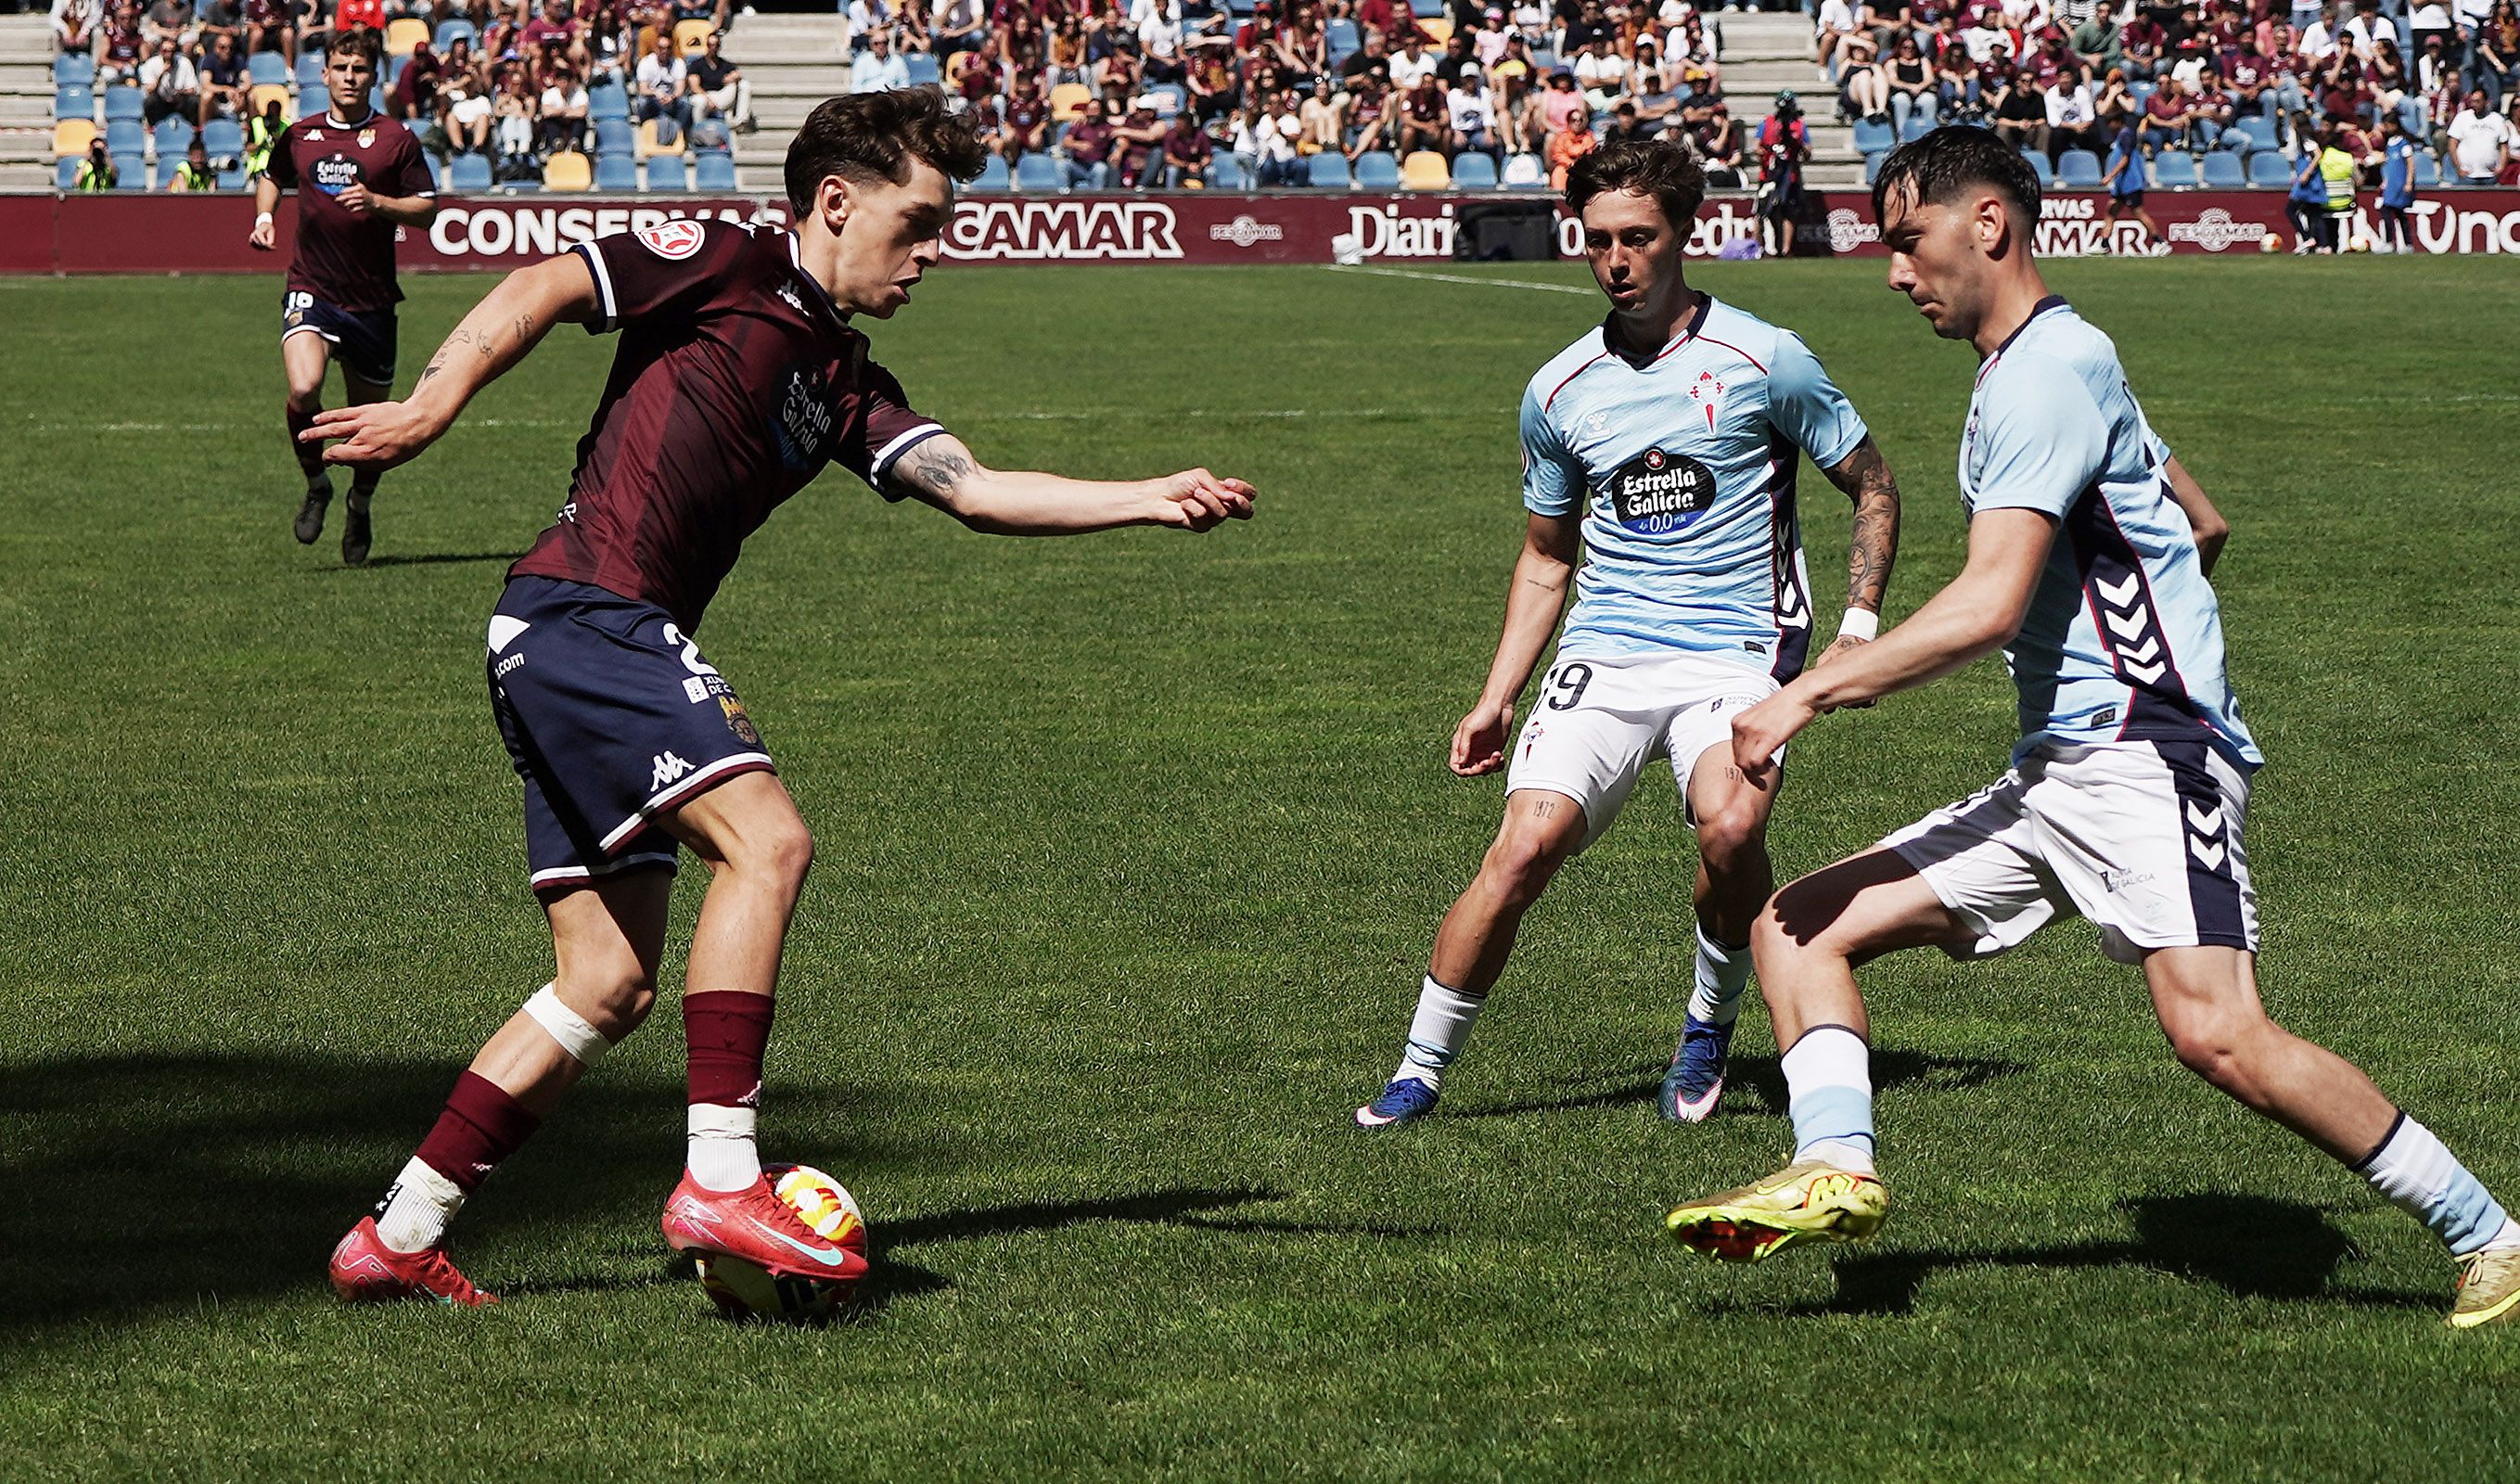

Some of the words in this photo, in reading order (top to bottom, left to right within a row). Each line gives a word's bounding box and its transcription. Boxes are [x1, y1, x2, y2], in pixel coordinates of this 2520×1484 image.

[429, 208, 788, 256] CONSER
[939, 202, 1185, 260] CAMAR
[1348, 203, 1462, 257] Diari
[1622, 467, 1697, 495] Estrella
[1627, 488, 1695, 517] Galicia
[1531, 663, 1593, 711] 9
